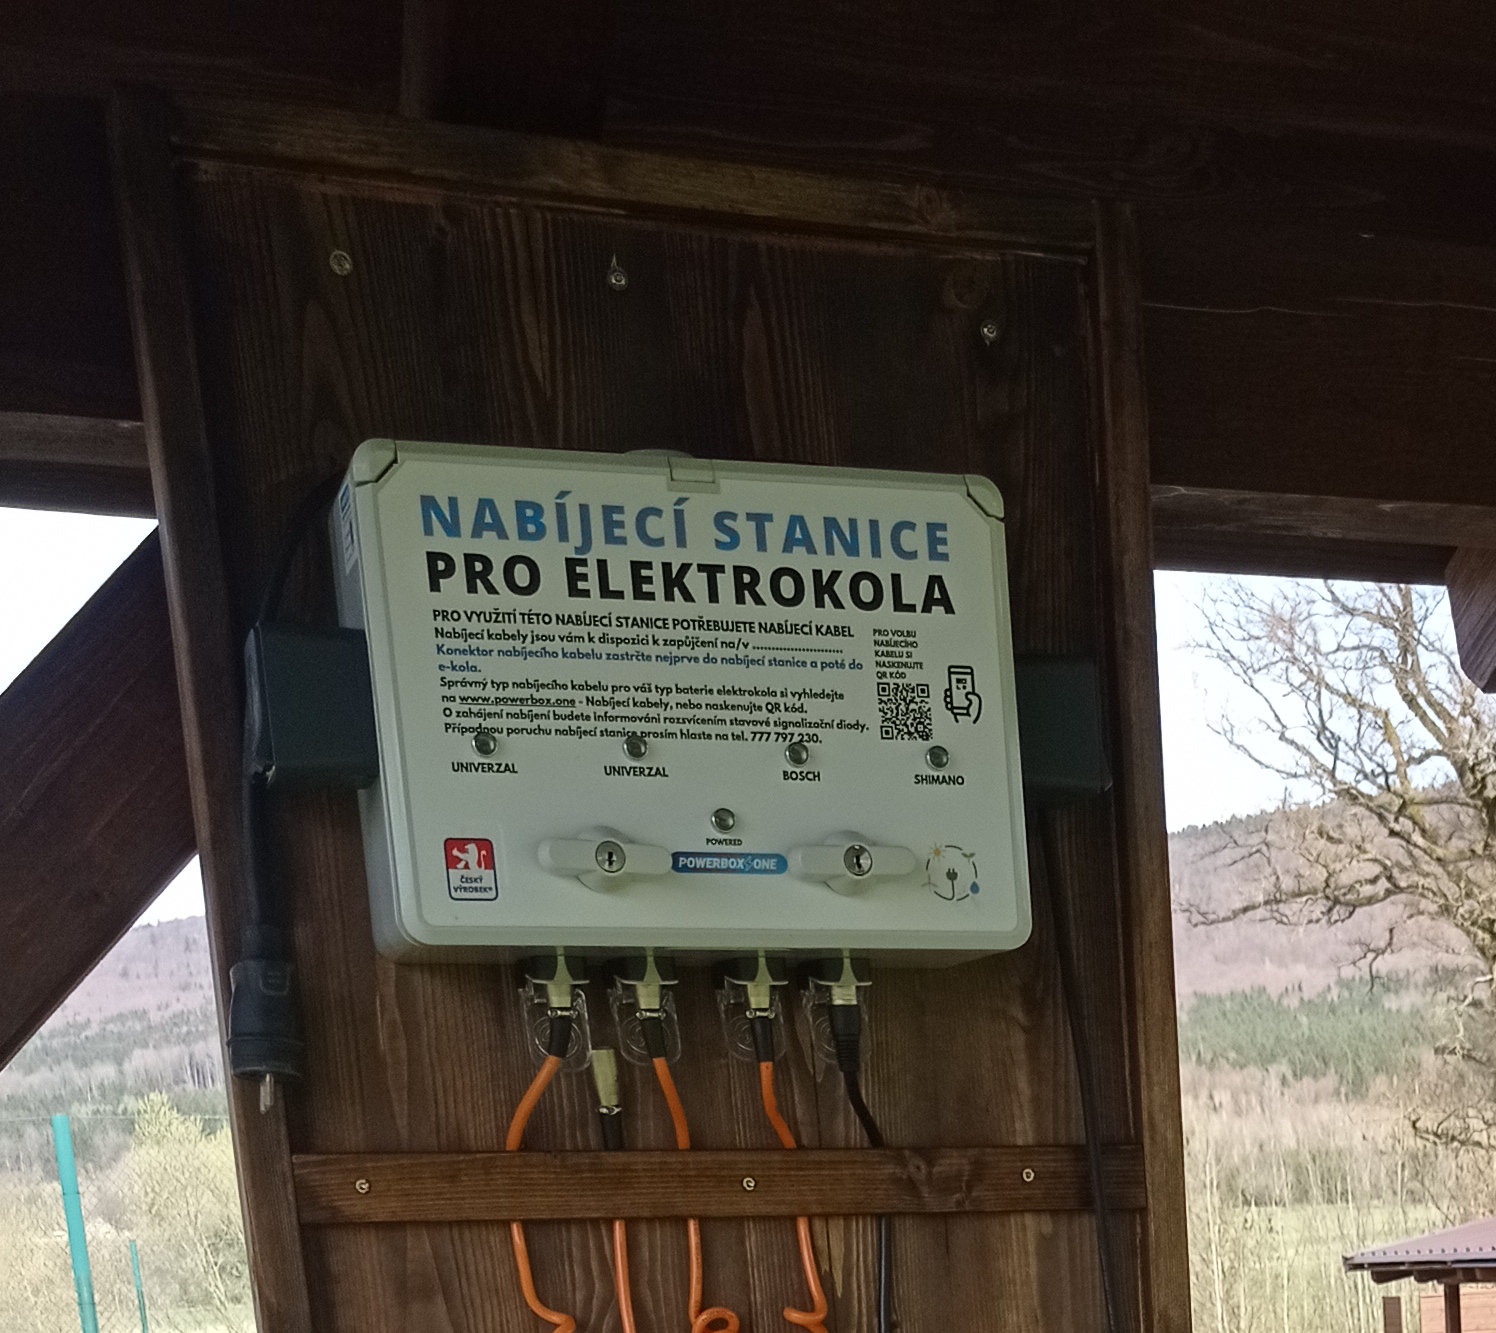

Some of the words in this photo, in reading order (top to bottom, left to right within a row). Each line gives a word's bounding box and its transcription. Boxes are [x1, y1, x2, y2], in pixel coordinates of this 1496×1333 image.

[420, 490, 690, 556] NABÍJECÍ
[713, 510, 950, 562] STANICE
[426, 551, 541, 596] PRO
[564, 556, 956, 615] ELEKTROKOLA
[432, 609, 461, 622] PRO
[463, 607, 517, 624] VYUŽITÍ
[519, 609, 552, 625] TÉTO
[556, 611, 612, 627] NABÍJECÍ
[615, 616, 670, 630] STANICE
[672, 615, 755, 633] POTŘEBUJETE
[758, 619, 813, 635] NABÍJECÍ
[816, 624, 854, 637] KABEL
[434, 627, 485, 643] Nabíjecí
[487, 628, 528, 644] kabely
[530, 630, 555, 644] jsou
[558, 631, 585, 643] vám
[587, 631, 596, 644] k
[598, 632, 649, 648] dispozici
[652, 634, 660, 646] k
[662, 635, 718, 650] zapůjčení
[721, 638, 750, 651] na/v
[873, 628, 889, 637] PRO
[436, 643, 494, 657] Konektor
[497, 645, 559, 660] nabíjecího
[561, 647, 602, 660] kabelu
[606, 650, 652, 662] zastrčte
[655, 652, 699, 666] nejprve
[703, 653, 718, 664] do
[721, 654, 765, 669] nabíjecí
[768, 656, 808, 668] stanice
[810, 660, 818, 669] a
[820, 659, 846, 671] poté
[848, 658, 863, 670] do
[438, 660, 482, 673] e-kola.
[876, 671, 888, 680] QR
[440, 676, 488, 691] Správný
[490, 680, 510, 692] typ
[512, 678, 569, 692] nabíjecího
[571, 680, 608, 692] kabelu
[611, 684, 631, 694] pro
[633, 682, 653, 694] váš
[655, 684, 673, 697] typ
[675, 683, 714, 695] baterie
[717, 685, 777, 698] elektrokola
[780, 688, 788, 698] si
[790, 688, 845, 703] vyhledejte
[441, 695, 457, 703] na
[458, 694, 576, 707] www.powerbox.one
[585, 696, 630, 710] Nabíjecí
[632, 697, 674, 711] kabely,
[675, 699, 703, 710] nebo
[705, 700, 763, 714] naskenujte
[765, 702, 782, 714] QR
[784, 702, 808, 714] kód.
[443, 707, 453, 718] O
[455, 707, 503, 721] zahájení
[506, 708, 550, 722] nabíjení
[553, 710, 591, 722] budete
[663, 714, 727, 726] rozsvícením
[730, 717, 771, 727] stavové
[773, 717, 834, 730] signalizační
[837, 719, 869, 733] diody.
[444, 722, 504, 737] Případnou
[506, 725, 552, 737] poruchu
[555, 726, 597, 739] nabíjecí
[641, 729, 678, 739] prosím
[680, 729, 713, 740] hlaste
[715, 732, 729, 741] na
[731, 731, 749, 742] tel.
[750, 731, 771, 742] 777
[774, 732, 795, 743] 797
[797, 733, 823, 744] 230.
[451, 762, 518, 774] UNIVERZAL
[603, 765, 669, 778] UNIVERZAL
[782, 770, 821, 782] BOSCH
[914, 774, 965, 786] SHIMANO
[706, 838, 743, 847] POWERED
[678, 857, 745, 870] POWERBOX
[753, 859, 778, 870] ONE
